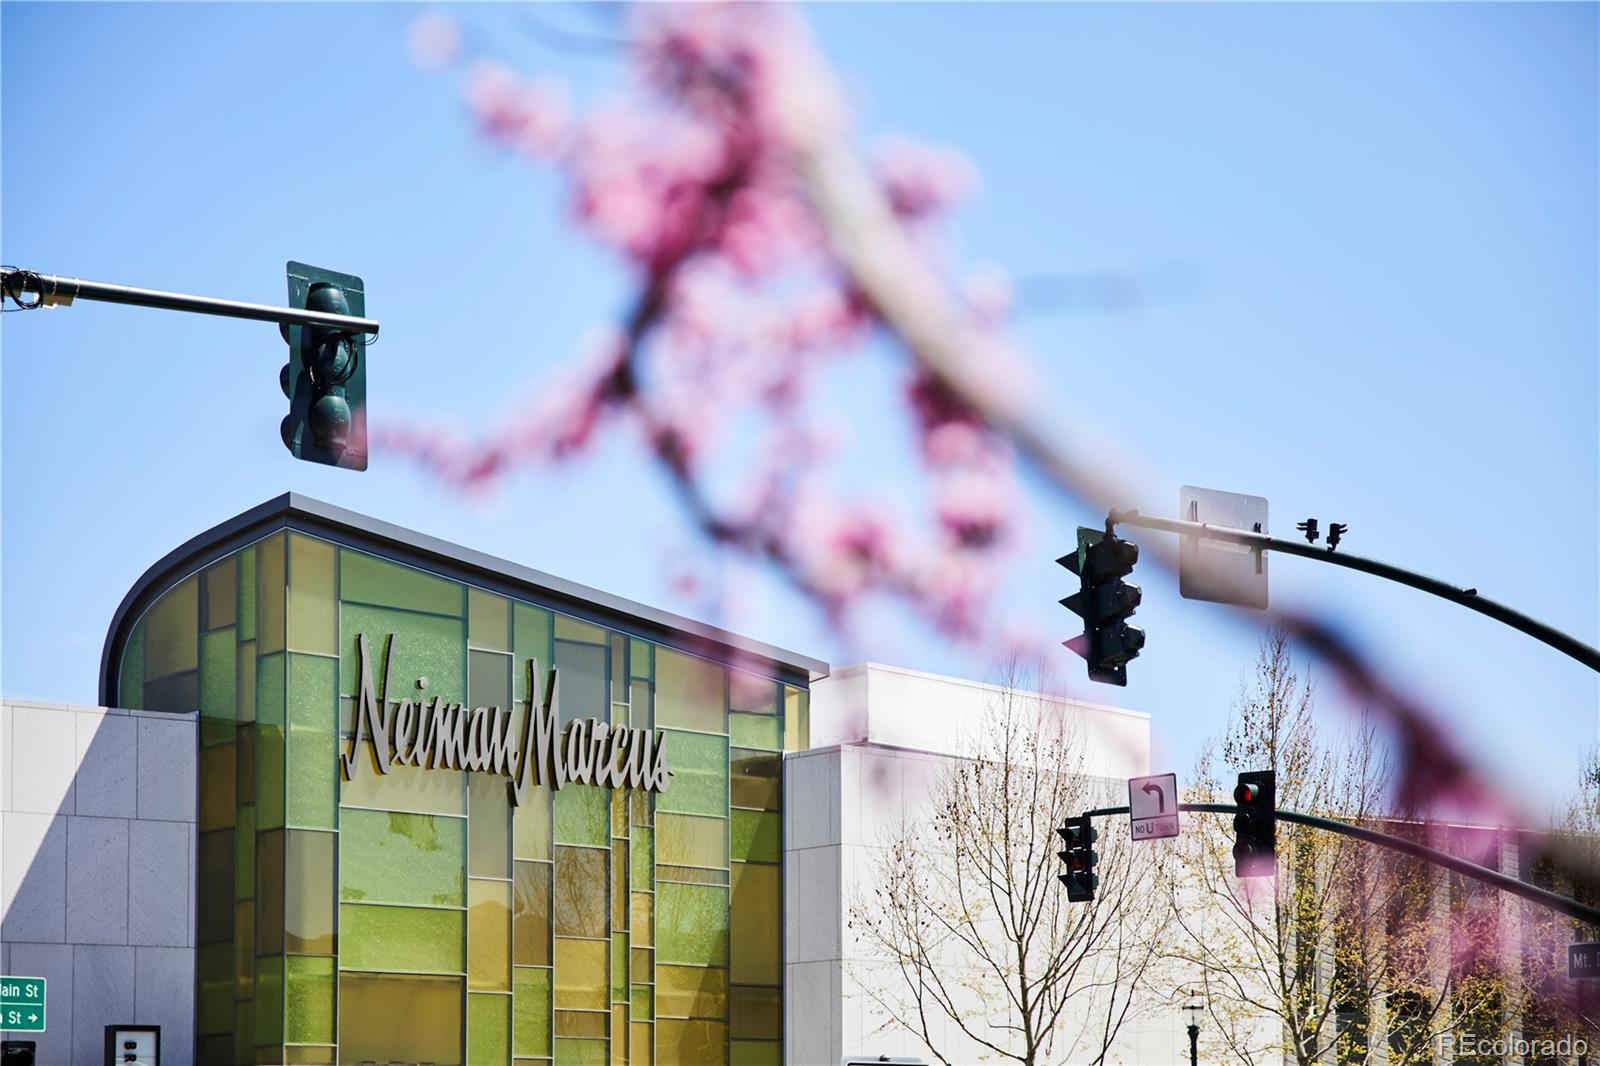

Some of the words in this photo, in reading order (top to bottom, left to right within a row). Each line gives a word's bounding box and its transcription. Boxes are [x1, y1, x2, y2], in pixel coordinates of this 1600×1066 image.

[340, 632, 518, 782] Neiman
[510, 656, 675, 807] Marcus
[1135, 824, 1145, 834] NO
[1146, 822, 1154, 834] U
[1573, 952, 1592, 969] Mt.
[0, 983, 20, 997] ain
[25, 983, 38, 998] St
[8, 1010, 21, 1024] St
